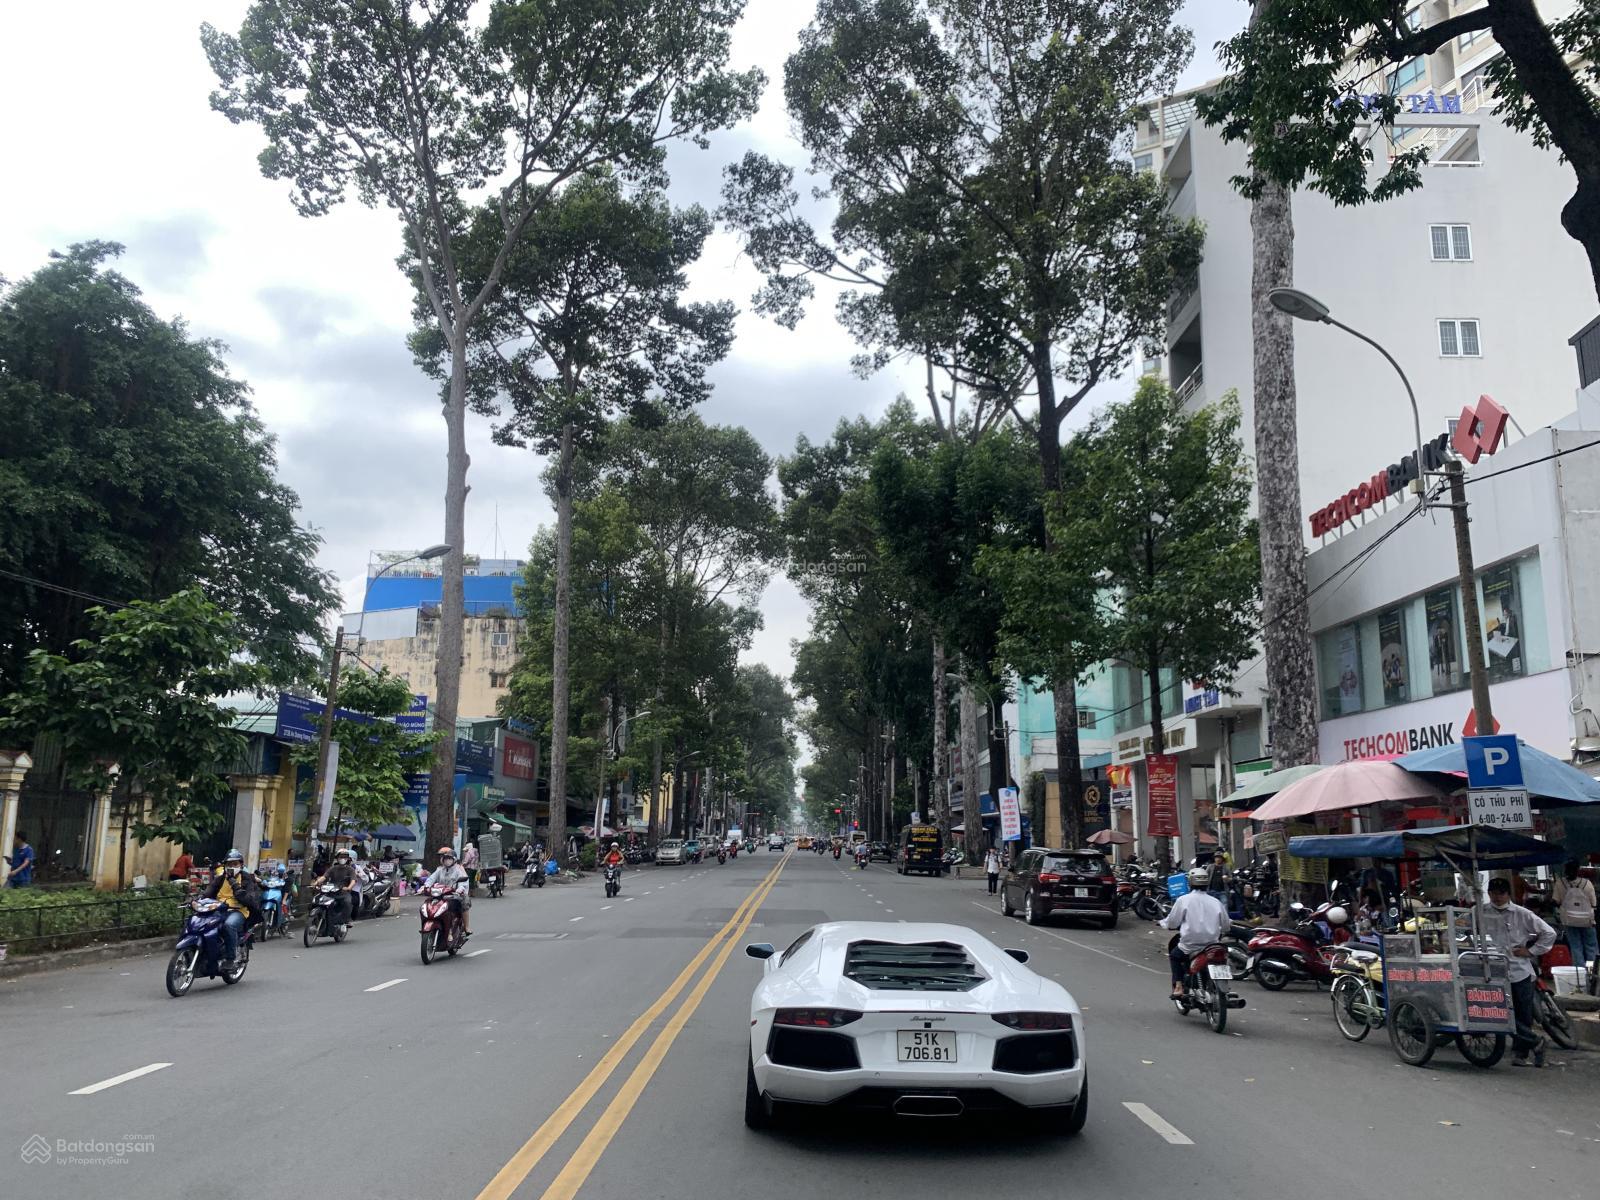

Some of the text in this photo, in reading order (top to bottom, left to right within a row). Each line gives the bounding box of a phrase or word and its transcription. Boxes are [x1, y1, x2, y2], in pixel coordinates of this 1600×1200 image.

[1406, 89, 1462, 113] TÂM
[1309, 433, 1449, 538] TECHCOMBANK
[1344, 722, 1455, 760] TECHCOMBANK
[1484, 747, 1509, 776] P
[1474, 796, 1486, 808] CÓ
[1510, 793, 1524, 807] PHÍ
[1478, 813, 1524, 824] 6:00-24:00
[914, 1032, 939, 1046] 51K
[904, 1046, 950, 1061] 706.81
